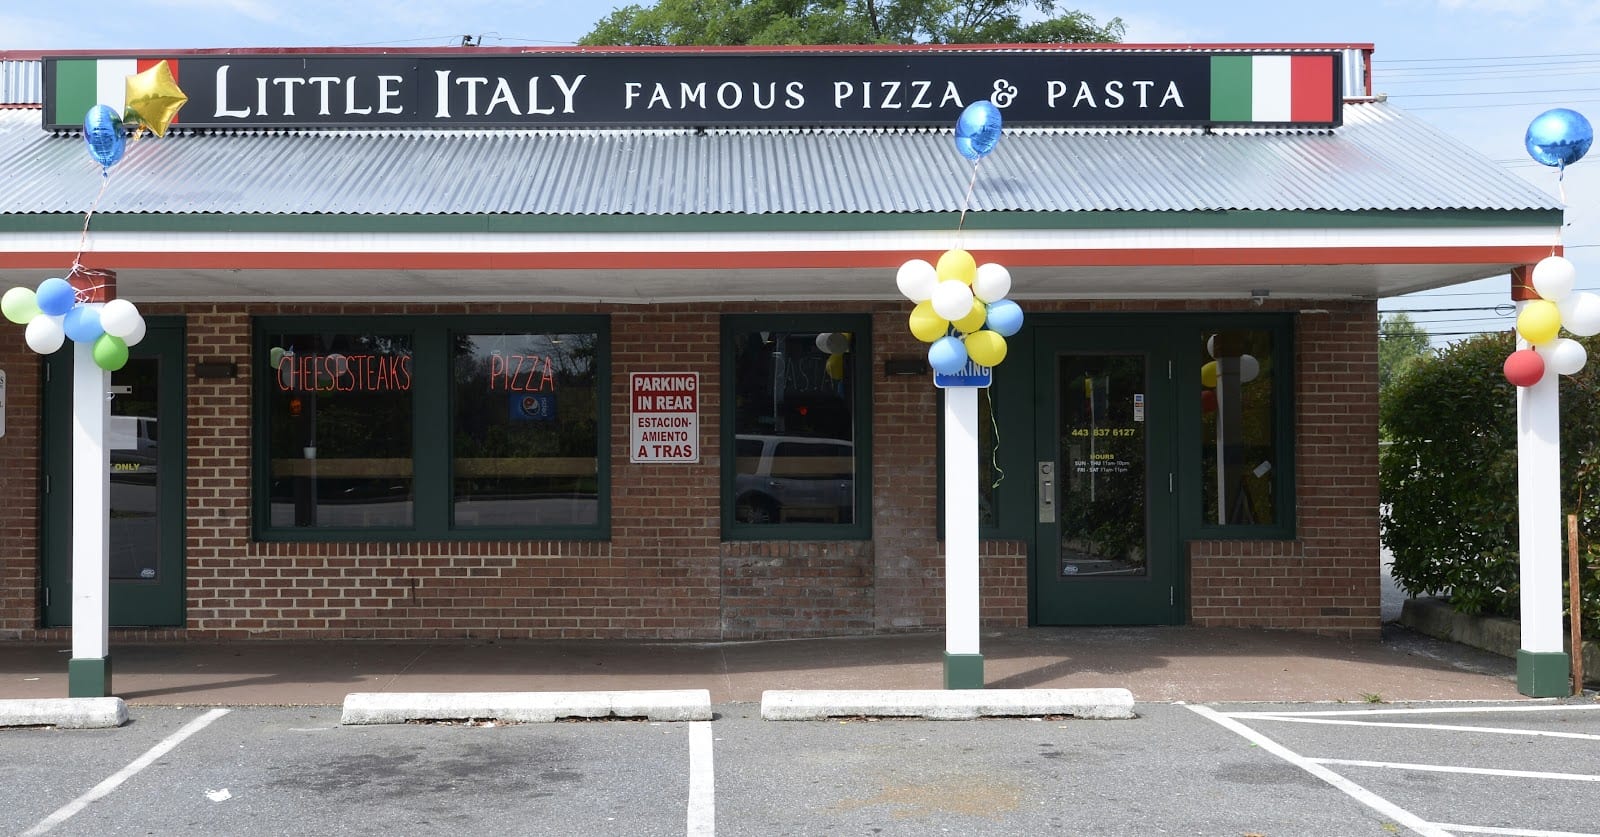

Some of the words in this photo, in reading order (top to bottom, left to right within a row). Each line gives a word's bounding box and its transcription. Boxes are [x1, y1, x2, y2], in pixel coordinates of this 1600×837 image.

[213, 65, 404, 119] LITTLE
[434, 70, 588, 119] ITALY
[624, 81, 805, 110] FAMOUS
[834, 80, 965, 110] PIZZA
[990, 78, 1018, 109] &
[1047, 80, 1185, 109] PASTA
[277, 354, 411, 392] CHEESESTEAKS
[490, 354, 555, 392] PIZZA
[634, 377, 695, 391] PARKING
[638, 396, 652, 410] IN
[656, 395, 693, 410] REAR
[638, 417, 692, 428] ESTACION-
[641, 431, 689, 442] AMIENTO
[1071, 428, 1089, 437] 443
[1112, 428, 1135, 437] 6127
[637, 445, 649, 458] A
[652, 444, 693, 458] TRAS
[114, 463, 140, 471] ONLY
